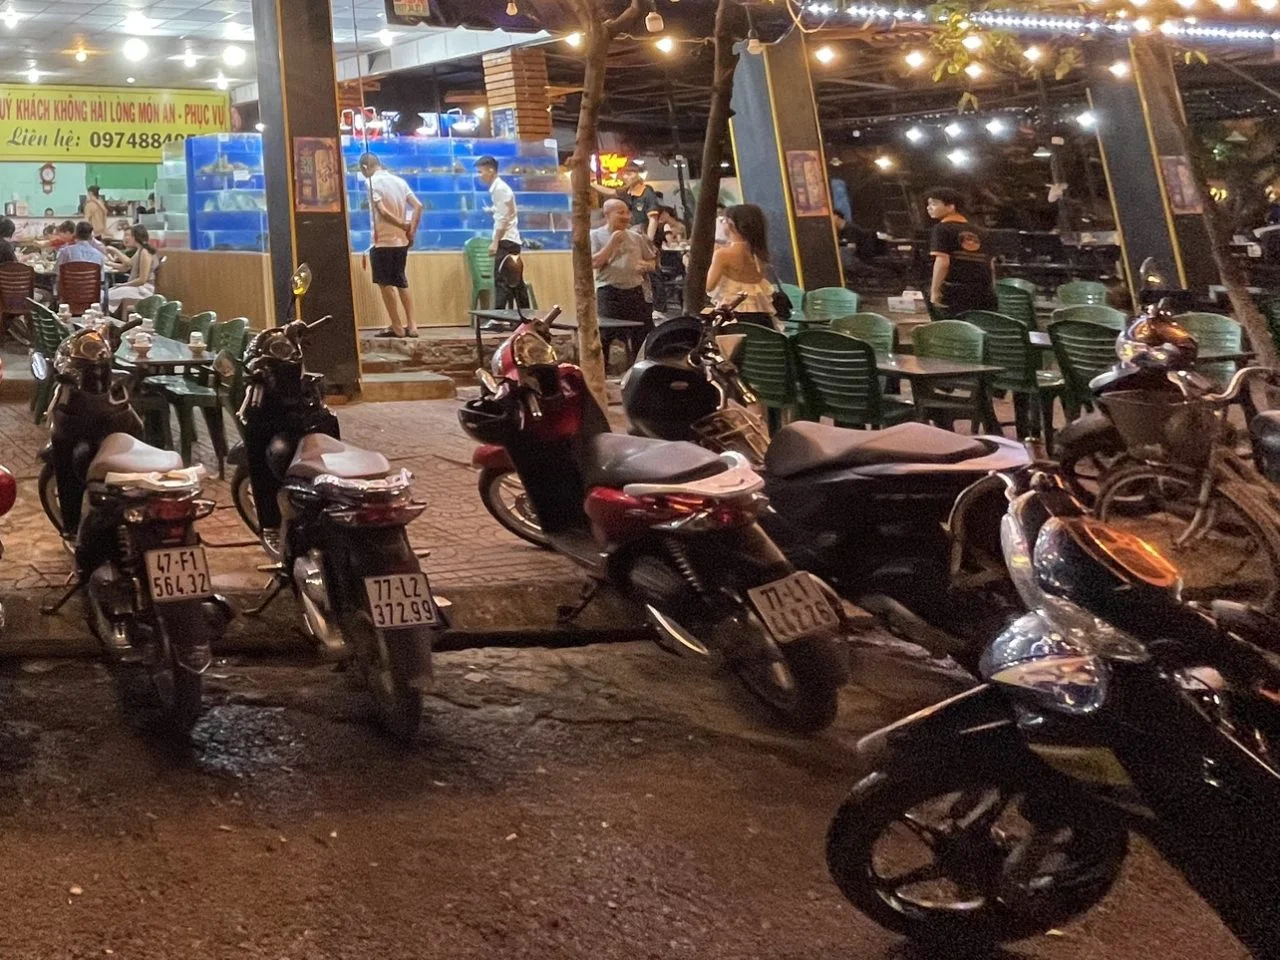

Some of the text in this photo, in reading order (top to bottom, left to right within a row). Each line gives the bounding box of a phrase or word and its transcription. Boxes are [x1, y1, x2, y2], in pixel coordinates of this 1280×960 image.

[16, 93, 51, 121] KHÁCH
[53, 94, 88, 122] KHÔNG
[7, 126, 197, 153] Liên hệ: 0974884
[156, 550, 199, 574] 47-F1
[153, 572, 209, 598] 564.32
[373, 576, 422, 602] 77-L2
[374, 599, 434, 625] 372.99
